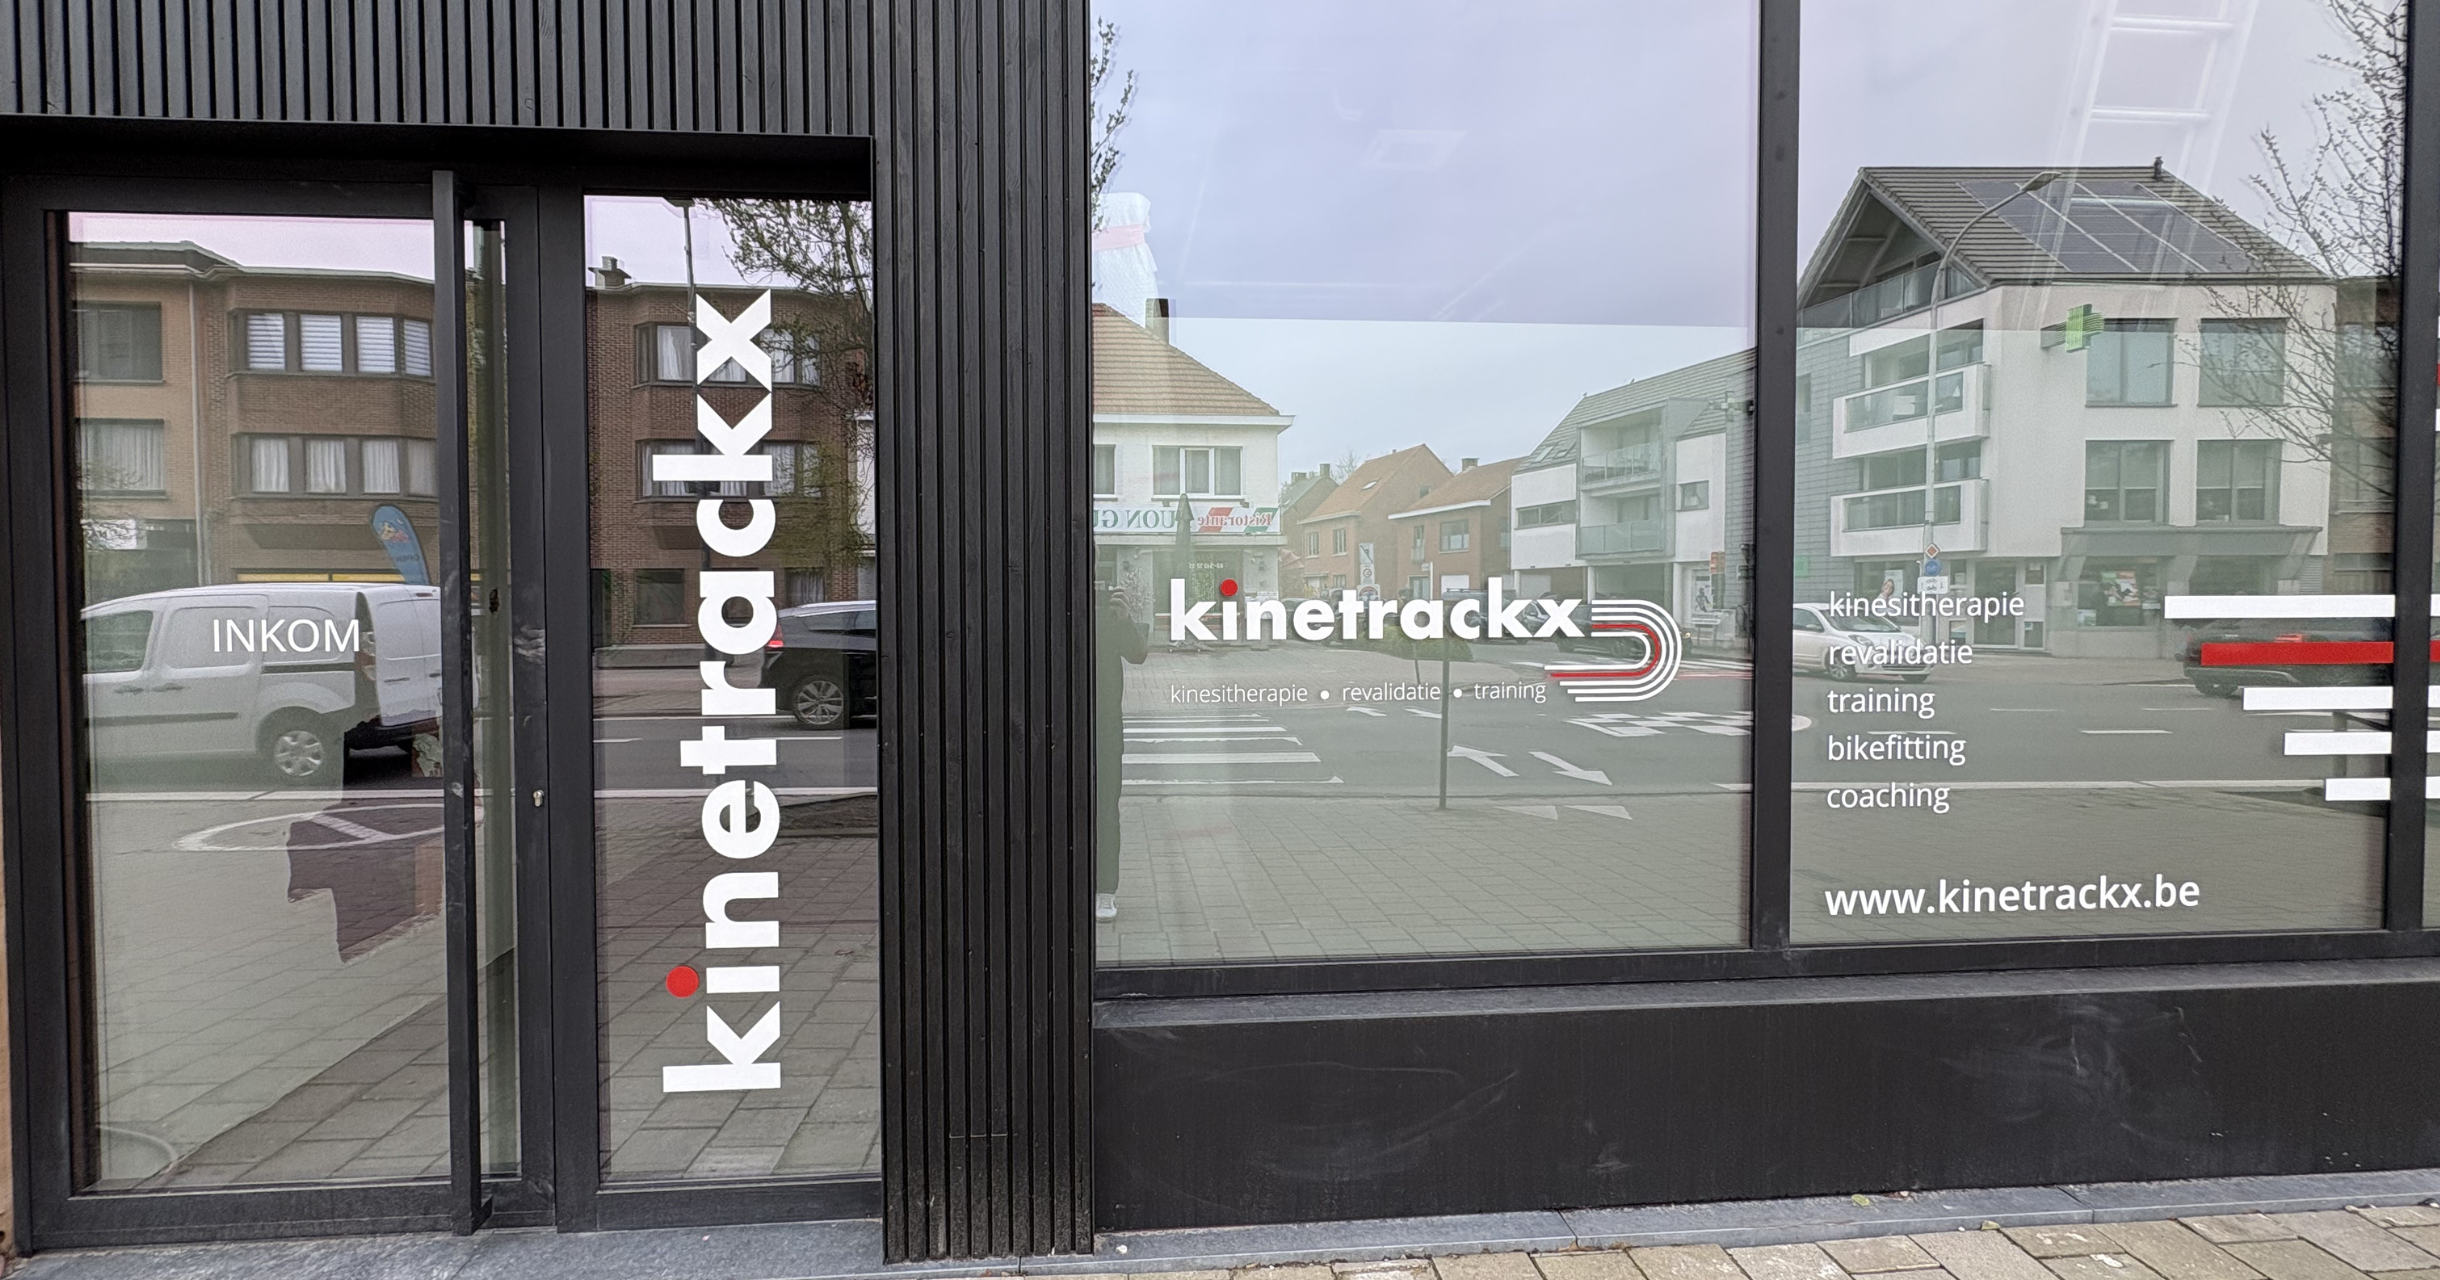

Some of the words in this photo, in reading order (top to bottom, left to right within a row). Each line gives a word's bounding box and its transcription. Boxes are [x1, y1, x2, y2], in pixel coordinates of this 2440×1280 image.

[1170, 577, 1585, 641] kinetrackx
[1829, 591, 2024, 623] kinesitherapie
[213, 619, 360, 653] INKOM
[1829, 639, 1973, 666] revalidatie
[652, 289, 782, 1093] kinetrackx
[1170, 684, 1308, 707] kinesitherapie
[1342, 682, 1441, 702] revalidatie
[1473, 682, 1547, 704] training
[1827, 687, 1936, 719] training
[1828, 735, 1966, 766] bikefitting
[1827, 782, 1950, 814] coaching
[1824, 873, 2200, 916] www.kinetrackx.be
